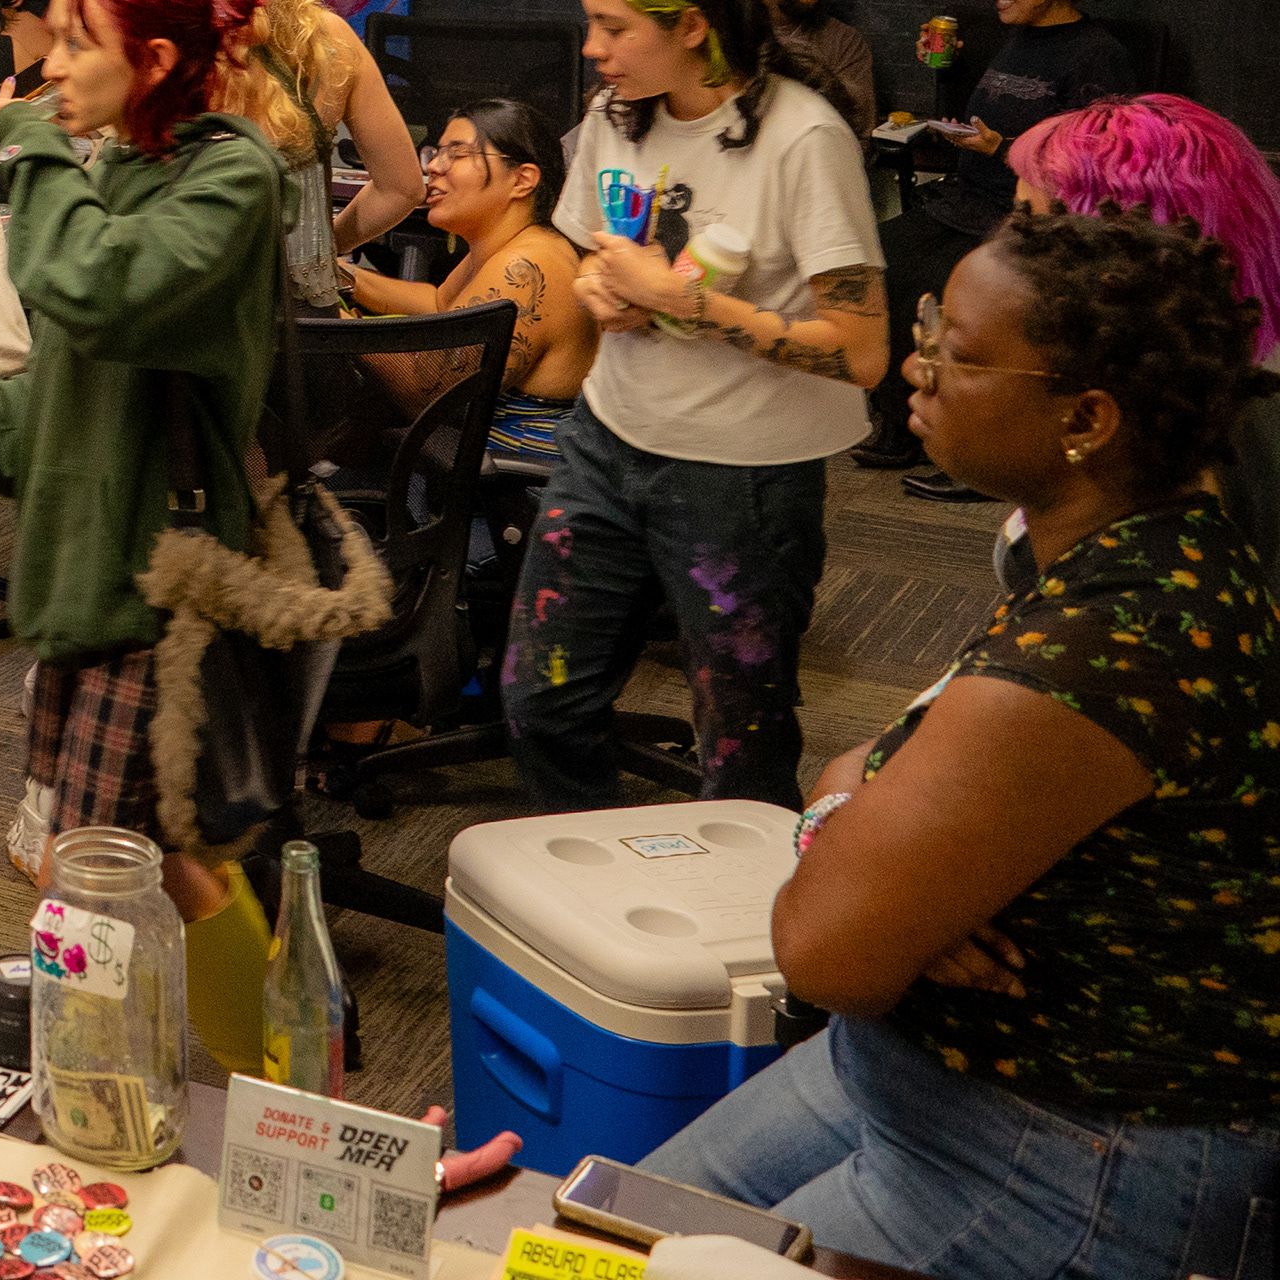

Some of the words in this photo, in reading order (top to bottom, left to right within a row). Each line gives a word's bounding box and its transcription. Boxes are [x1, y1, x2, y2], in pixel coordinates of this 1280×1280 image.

[262, 1106, 315, 1131] DONATE
[255, 1121, 330, 1152] SUPPORT
[339, 1124, 410, 1155] OPEN
[336, 1145, 397, 1173] MFA
[520, 1240, 586, 1274] ABSURD
